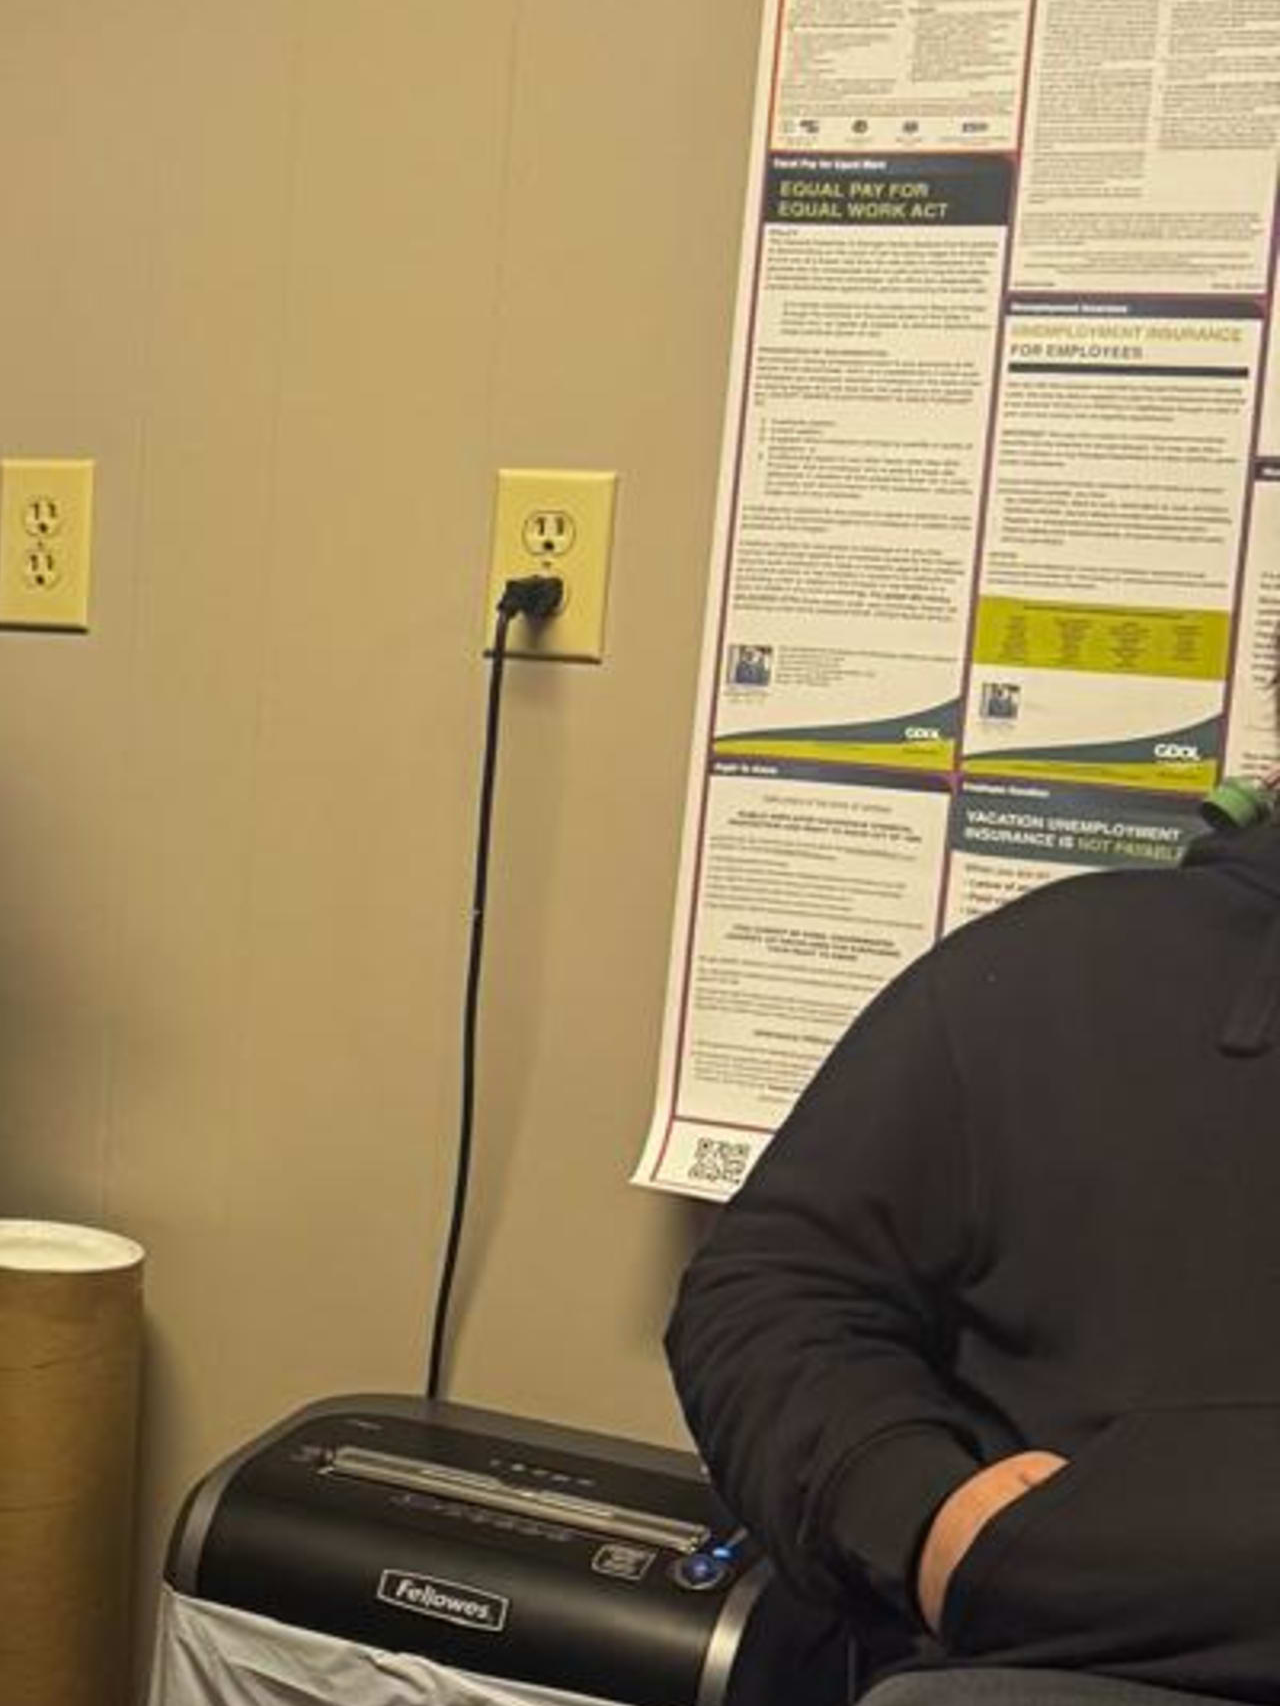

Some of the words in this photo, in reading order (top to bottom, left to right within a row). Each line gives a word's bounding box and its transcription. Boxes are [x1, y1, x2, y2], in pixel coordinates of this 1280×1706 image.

[780, 181, 844, 197] EQUAL
[850, 182, 886, 198] PAY
[889, 183, 929, 198] FOR
[777, 201, 842, 217] EQUAL
[847, 202, 906, 218] WORK
[910, 203, 949, 218] ACT
[1145, 326, 1242, 342] INSURANCE
[1010, 344, 1042, 357] FOR
[1046, 345, 1143, 359] EMPLOYEES
[967, 811, 1043, 828] VACATION
[1047, 819, 1182, 841] UNEMPLOYMENT
[964, 829, 1056, 847] INSURANCE
[1059, 835, 1074, 848] IS
[1077, 836, 1109, 851] NOT
[396, 1579, 489, 1618] Fellowes
